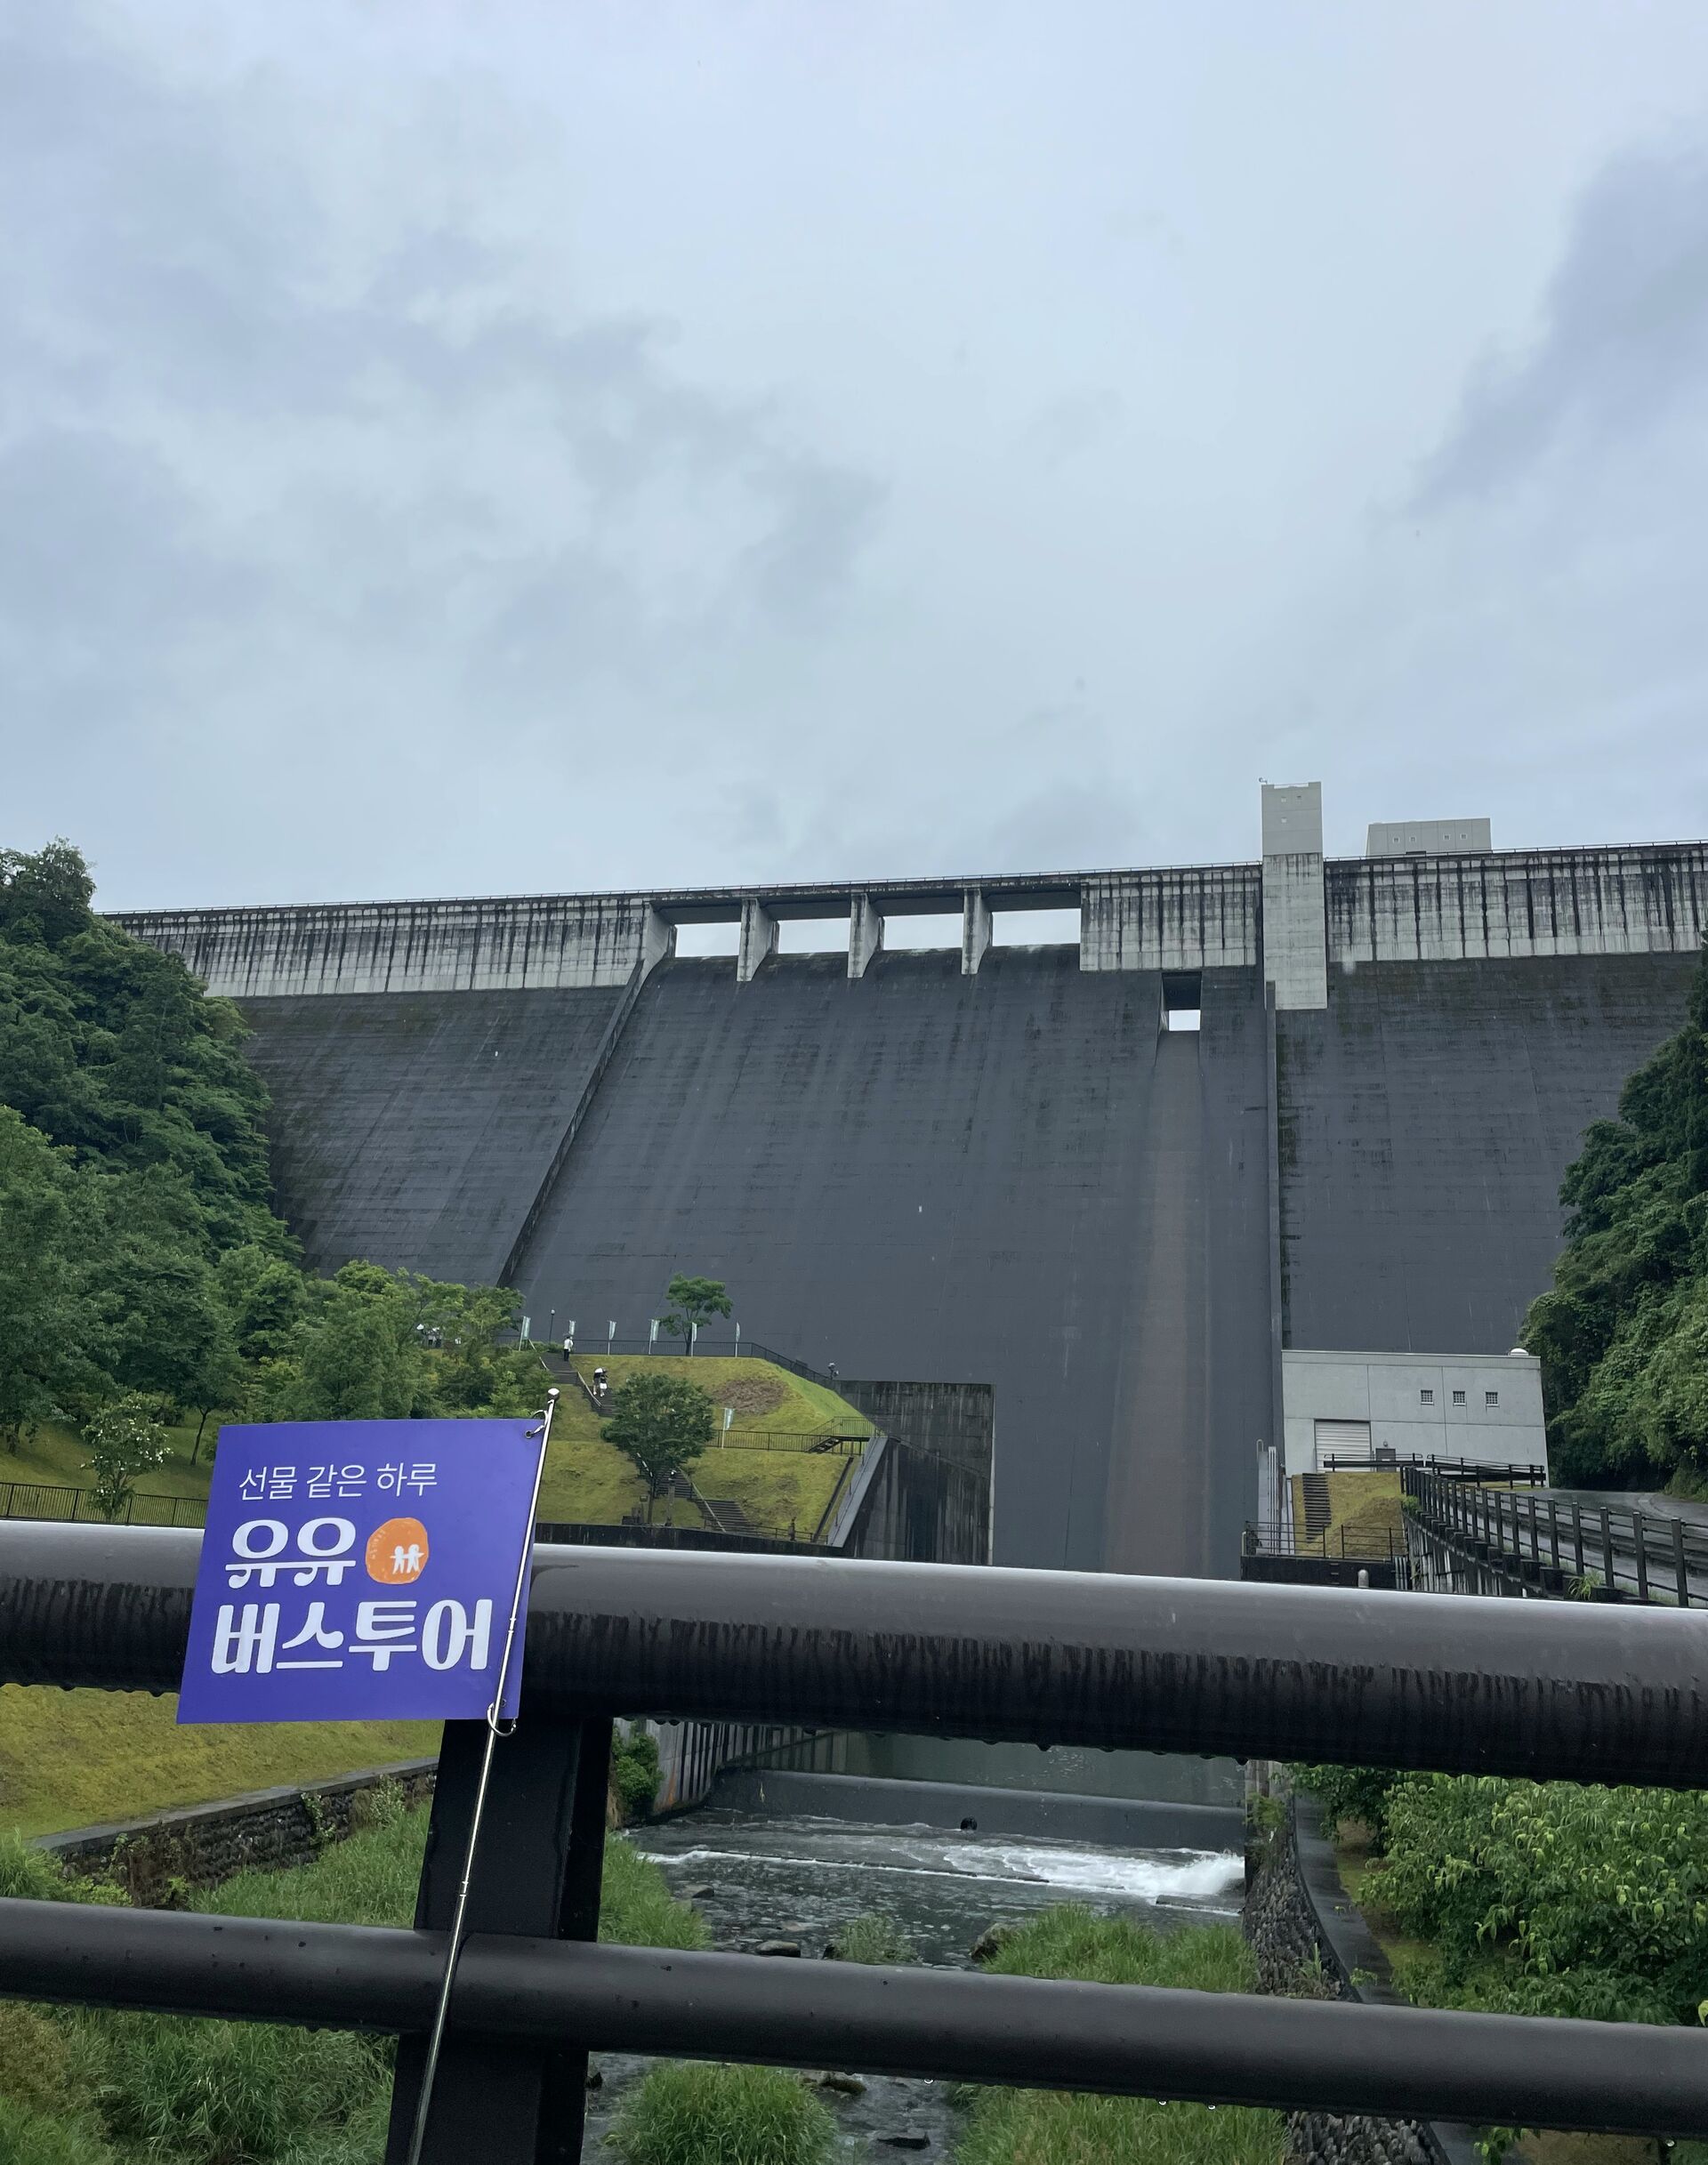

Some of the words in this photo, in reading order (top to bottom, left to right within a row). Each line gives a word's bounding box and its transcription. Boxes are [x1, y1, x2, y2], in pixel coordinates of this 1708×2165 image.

[238, 1466, 298, 1501] 선물
[306, 1464, 367, 1499] 같은
[376, 1462, 438, 1497] 하루
[224, 1517, 357, 1589] 유유
[211, 1598, 493, 1674] 버스투어
